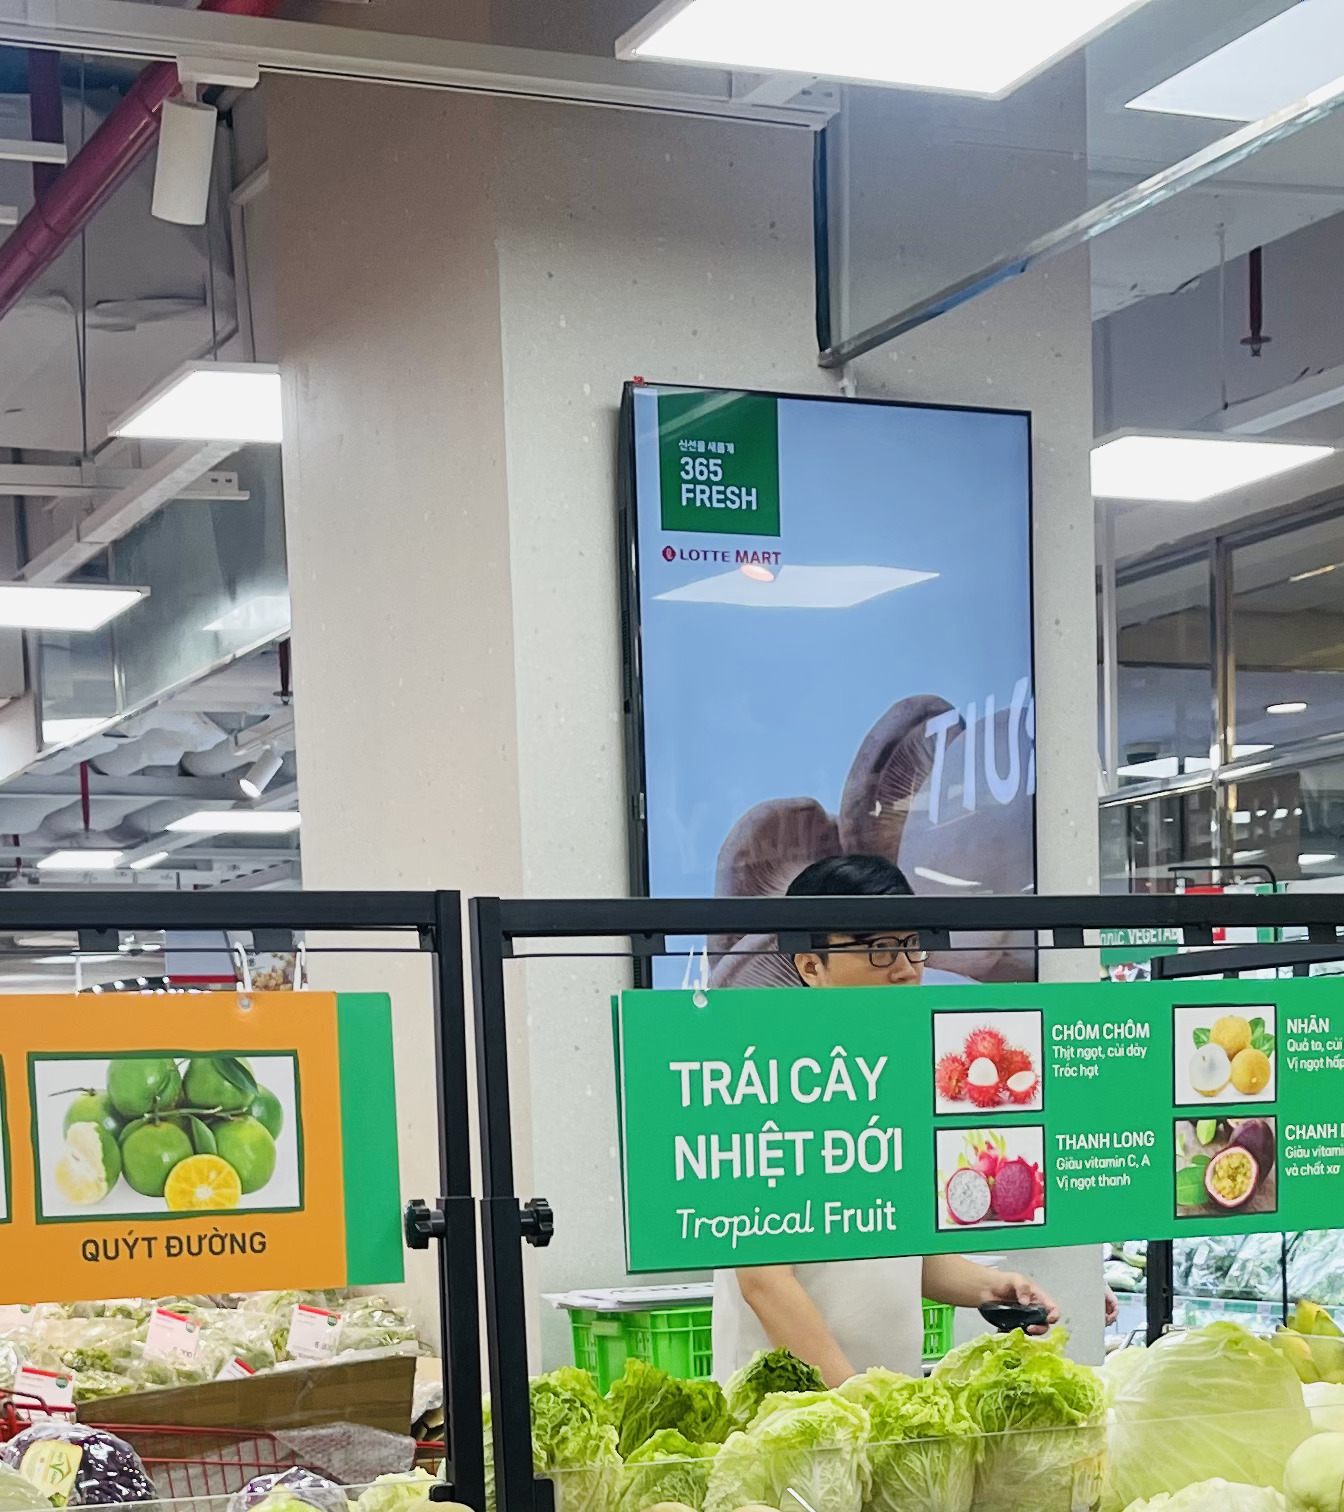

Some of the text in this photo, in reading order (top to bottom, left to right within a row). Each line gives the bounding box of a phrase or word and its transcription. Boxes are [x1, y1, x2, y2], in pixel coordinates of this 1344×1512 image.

[680, 457, 723, 481] 365
[681, 483, 757, 510] FRESH
[680, 549, 782, 566] LOTTE MART
[1051, 1018, 1151, 1041] CHÔM CHÔM
[1287, 1014, 1330, 1034] NHÃN
[1052, 1044, 1076, 1062] Thịt
[1076, 1045, 1106, 1061] ngọt,
[1287, 1038, 1310, 1052] Quả
[1311, 1039, 1325, 1052] to,
[1079, 1063, 1099, 1080] hạt
[1287, 1056, 1299, 1073] Vị
[1299, 1056, 1325, 1072] ngọt
[669, 1045, 888, 1107] TRÁI CÂY
[1055, 1130, 1155, 1151] THANH LONG
[1285, 1122, 1338, 1141] CHANH
[674, 1115, 903, 1188] NHIỆT ĐỚI
[1084, 1154, 1126, 1169] vitamin
[1127, 1153, 1140, 1169] C,
[1140, 1153, 1151, 1167] A
[1285, 1160, 1342, 1177] và chất xơ
[1056, 1172, 1131, 1192] Vị ngọt thanh
[675, 1198, 897, 1249] Tropical Fruit
[81, 1226, 267, 1263] QUÝT ĐƯỜNG
